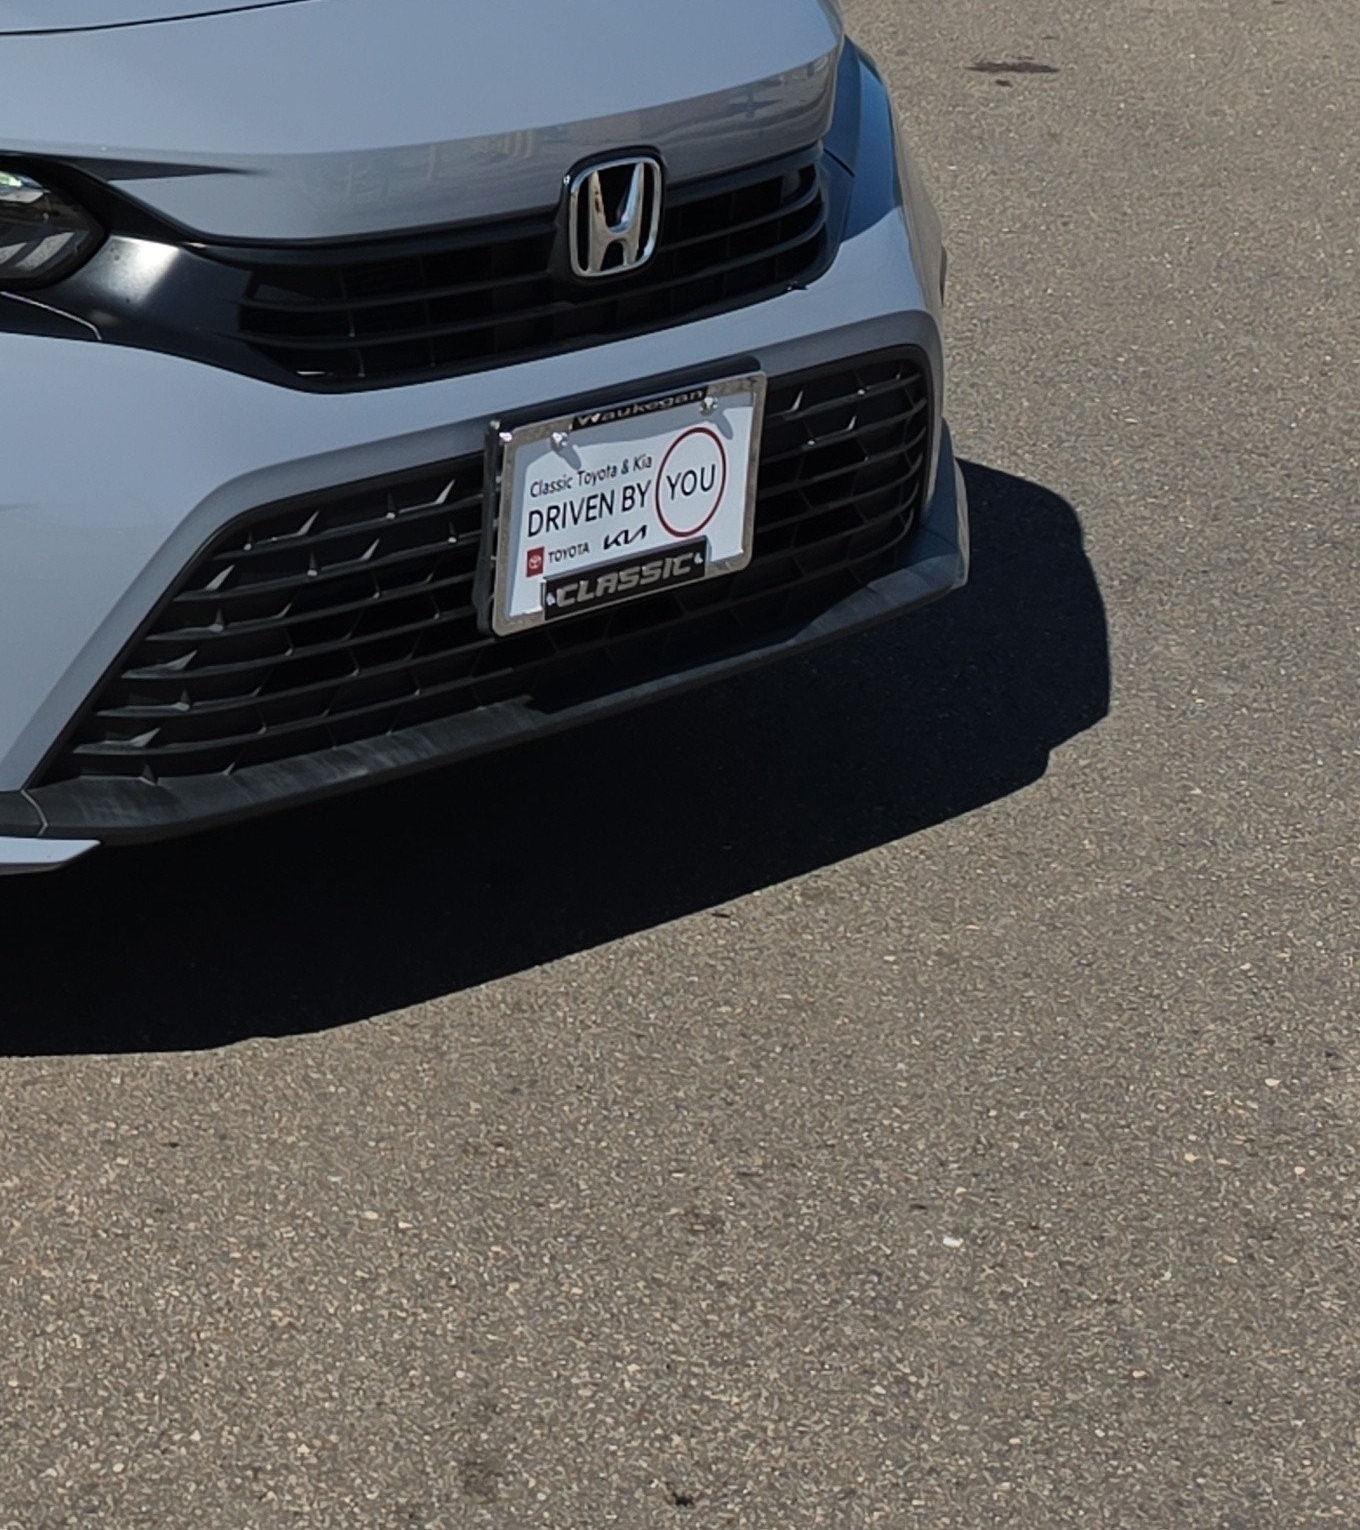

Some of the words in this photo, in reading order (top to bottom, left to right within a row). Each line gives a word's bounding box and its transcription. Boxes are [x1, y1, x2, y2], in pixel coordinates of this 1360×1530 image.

[576, 389, 705, 427] Waukegan
[529, 474, 573, 499] Classic
[577, 463, 618, 488] Toyota
[620, 462, 630, 476] &
[632, 453, 653, 472] Kia
[527, 488, 615, 538] DRIVEN
[620, 479, 652, 513] BY
[666, 463, 717, 502] YOU
[548, 541, 591, 565] TOYOTA
[555, 551, 695, 609] CLASSIC
